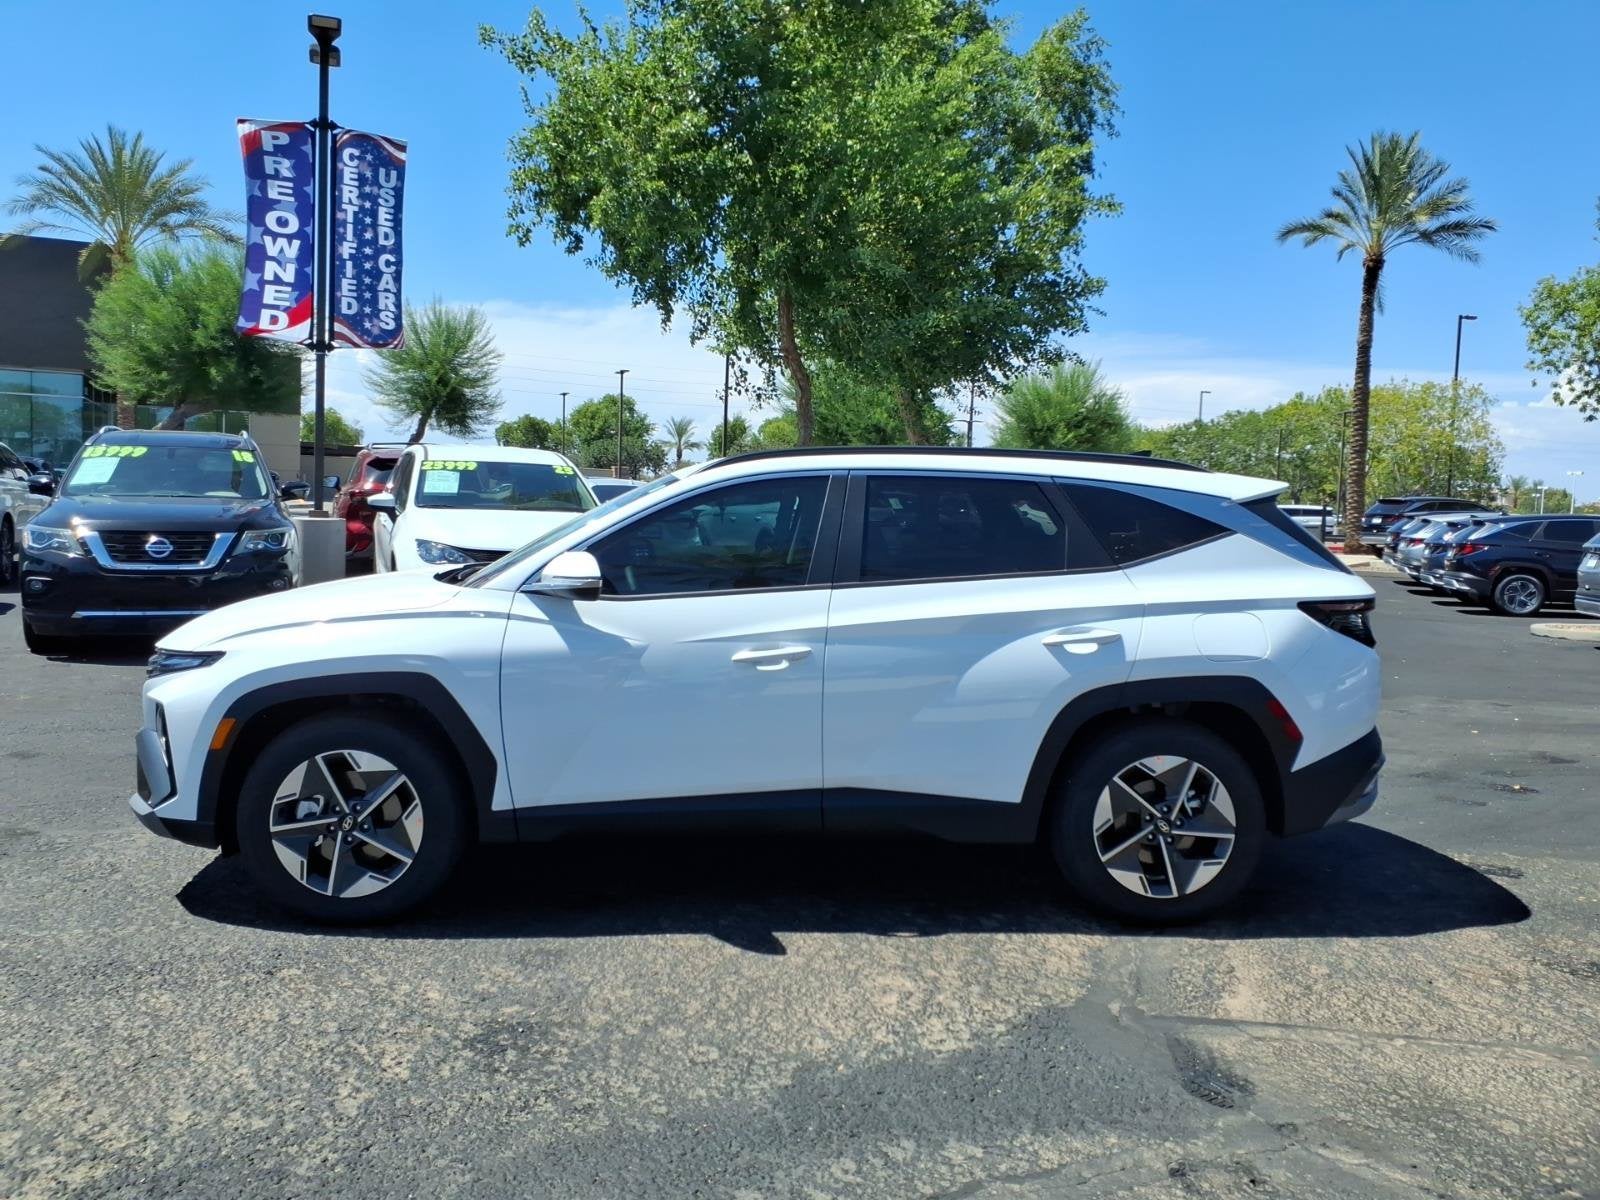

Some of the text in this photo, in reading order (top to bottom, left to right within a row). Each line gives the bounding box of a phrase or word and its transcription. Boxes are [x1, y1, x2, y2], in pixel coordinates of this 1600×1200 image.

[341, 148, 360, 315] CERTIFIED
[377, 167, 398, 330] USED CARS
